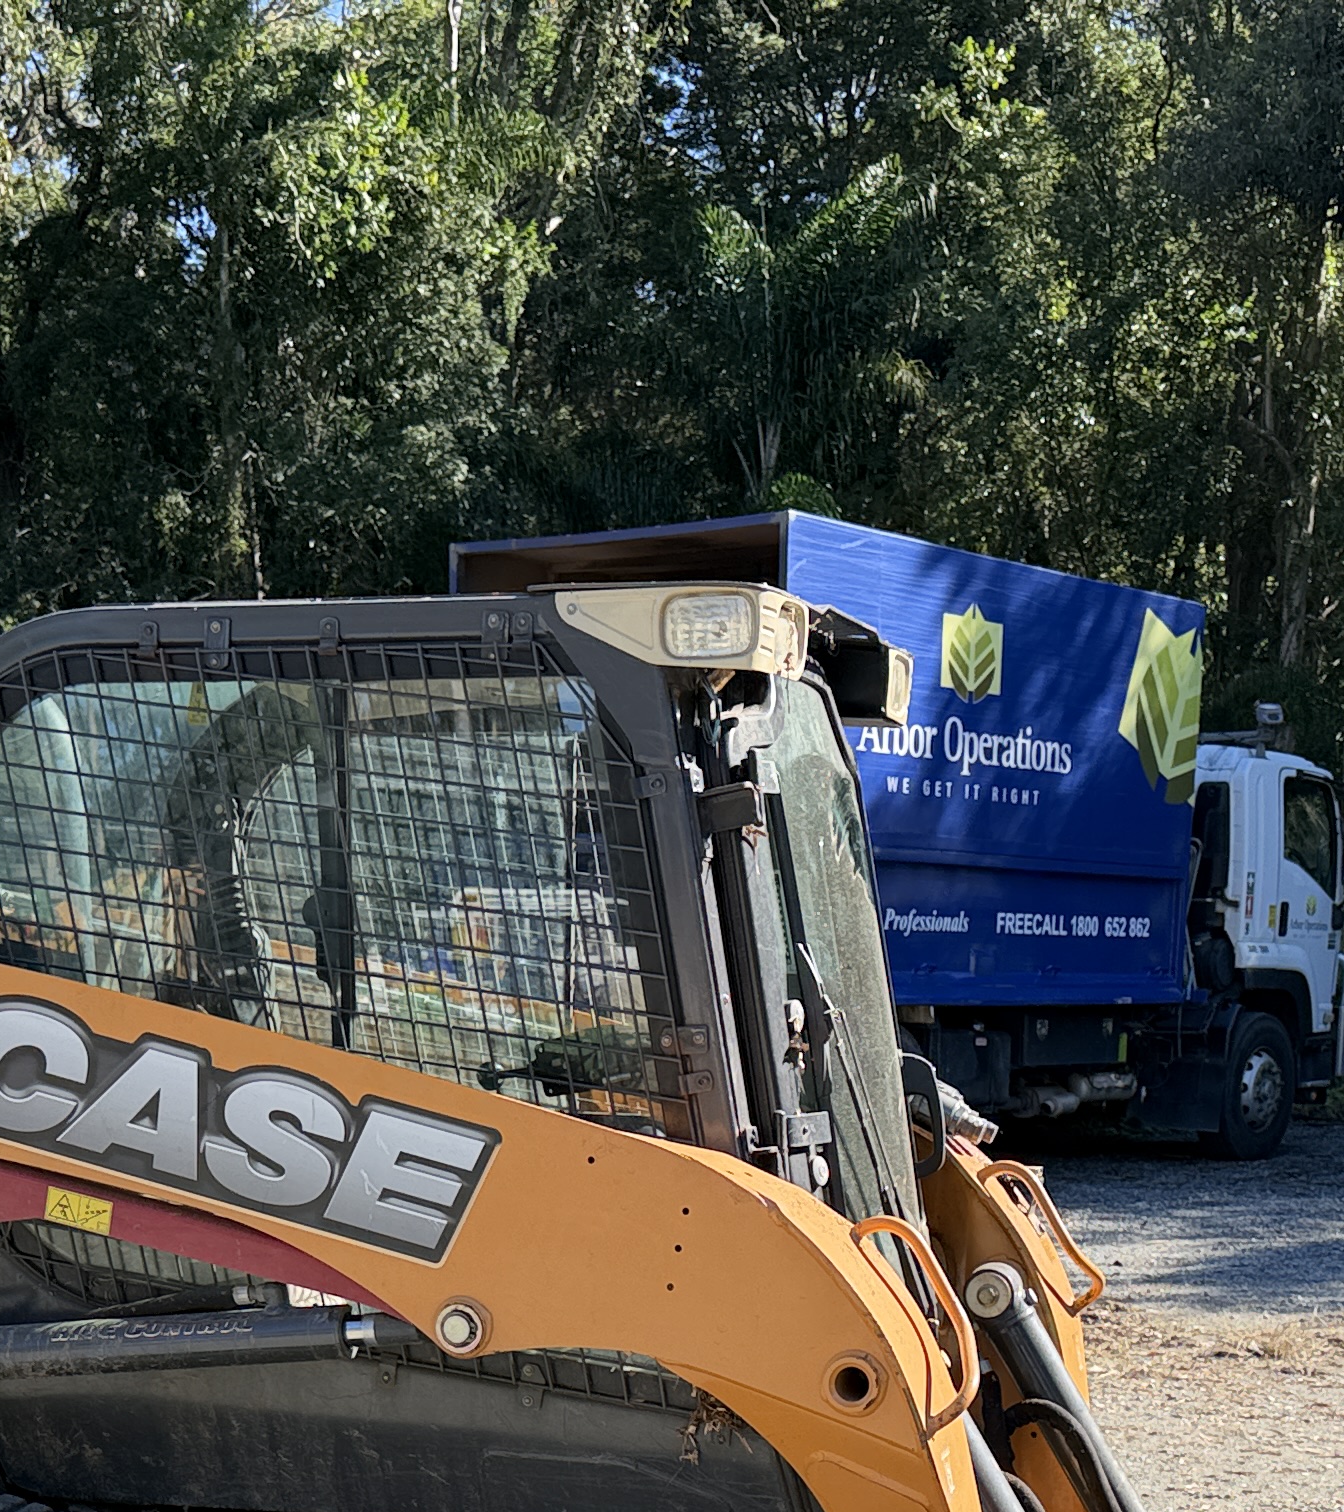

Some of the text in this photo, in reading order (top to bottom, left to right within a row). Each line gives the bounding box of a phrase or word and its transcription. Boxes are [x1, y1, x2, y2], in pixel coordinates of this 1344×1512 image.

[944, 716, 1072, 776] Operations
[887, 776, 1041, 806] WE GET IT RIGHT
[883, 908, 969, 937] Professionals
[996, 912, 1150, 938] FREECALL 1800 652 862
